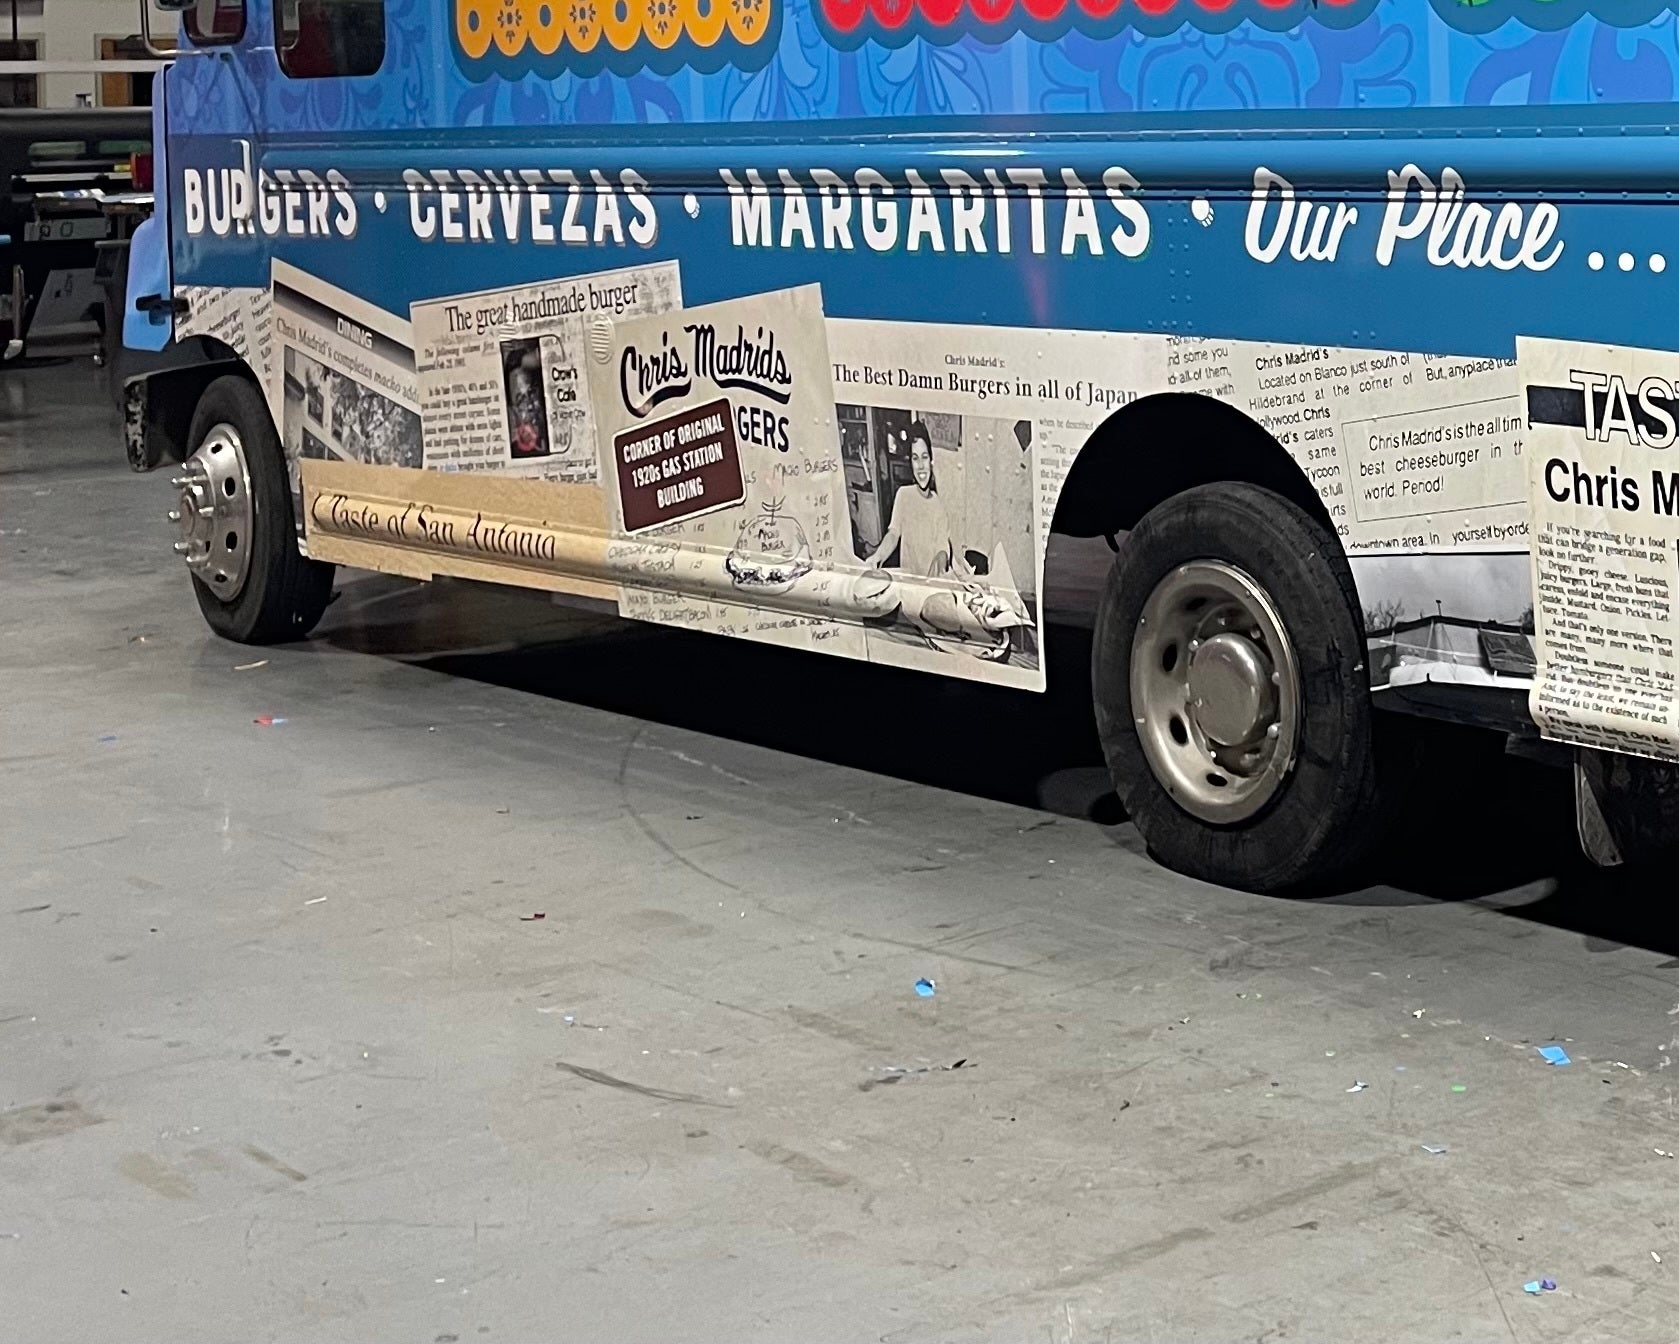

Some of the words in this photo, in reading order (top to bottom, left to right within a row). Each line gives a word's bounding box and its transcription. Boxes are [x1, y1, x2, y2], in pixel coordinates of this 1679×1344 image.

[184, 167, 358, 236] BURGERS
[402, 167, 659, 245] CERVEZAS
[719, 166, 1151, 257] MARGARITAS
[1244, 166, 1358, 264] Our
[1377, 163, 1565, 271] Place
[445, 306, 472, 333] The
[477, 304, 509, 335] great
[512, 285, 585, 323] handmade
[588, 284, 638, 315] burger
[336, 316, 373, 348] DINING
[276, 317, 296, 340] Chris
[299, 327, 332, 361] Madrid's
[333, 349, 373, 381] completes
[374, 370, 401, 394] macho
[620, 331, 691, 418] Chris
[684, 324, 792, 404] Madrids
[945, 354, 966, 366] Chris
[1183, 351, 1207, 363] some
[1212, 346, 1228, 361] you
[1256, 356, 1282, 370] Chris
[1285, 348, 1329, 365] Madrid's
[1258, 373, 1296, 390] Located
[1300, 372, 1312, 383] on
[1314, 366, 1347, 380] Blanco
[1350, 360, 1368, 377] just
[1371, 355, 1398, 370] south
[1400, 352, 1410, 366] of
[1426, 367, 1447, 382] But,
[1449, 359, 1494, 379] anyplace
[833, 364, 860, 383] The
[864, 366, 894, 386] Best
[898, 368, 944, 390] Damn
[948, 372, 1011, 399] Burgers
[1016, 376, 1032, 397] in
[1038, 379, 1059, 399] all
[1065, 381, 1083, 401] of
[1086, 383, 1137, 409] Japan
[1216, 384, 1235, 396] with
[1248, 391, 1305, 410] Hildebrand
[1315, 388, 1324, 400] at
[1333, 384, 1350, 397] the
[1360, 376, 1393, 392] corner
[1402, 372, 1413, 385] of
[733, 405, 790, 453] GERS
[1304, 406, 1330, 421] Chris
[622, 436, 661, 463] CORNER
[663, 432, 675, 448] OF
[677, 413, 725, 445] ORIGINAL
[1274, 431, 1299, 444] rid's
[1304, 427, 1334, 441] caters
[1369, 432, 1400, 451] Chris
[1401, 425, 1452, 447] Madrid's
[1454, 424, 1463, 439] is
[1465, 420, 1485, 438] the
[1487, 416, 1501, 434] all
[632, 465, 661, 487] 1920s
[662, 458, 681, 479] GAS
[683, 442, 724, 473] STATION
[1308, 446, 1337, 460] same
[1360, 459, 1385, 477] best
[1395, 448, 1479, 472] cheeseburger
[1491, 442, 1501, 458] in
[1304, 465, 1340, 482] Tycoon
[1364, 482, 1397, 500] world.
[1402, 476, 1444, 496] Period!
[1545, 457, 1641, 512] Chris
[657, 478, 704, 509] BUILDING
[311, 493, 379, 532] Taste
[388, 502, 416, 539] of
[418, 504, 456, 547] San
[466, 512, 556, 561] Antonio
[1430, 532, 1440, 545] In
[1452, 525, 1492, 545] yourself
[1494, 525, 1506, 540] by
